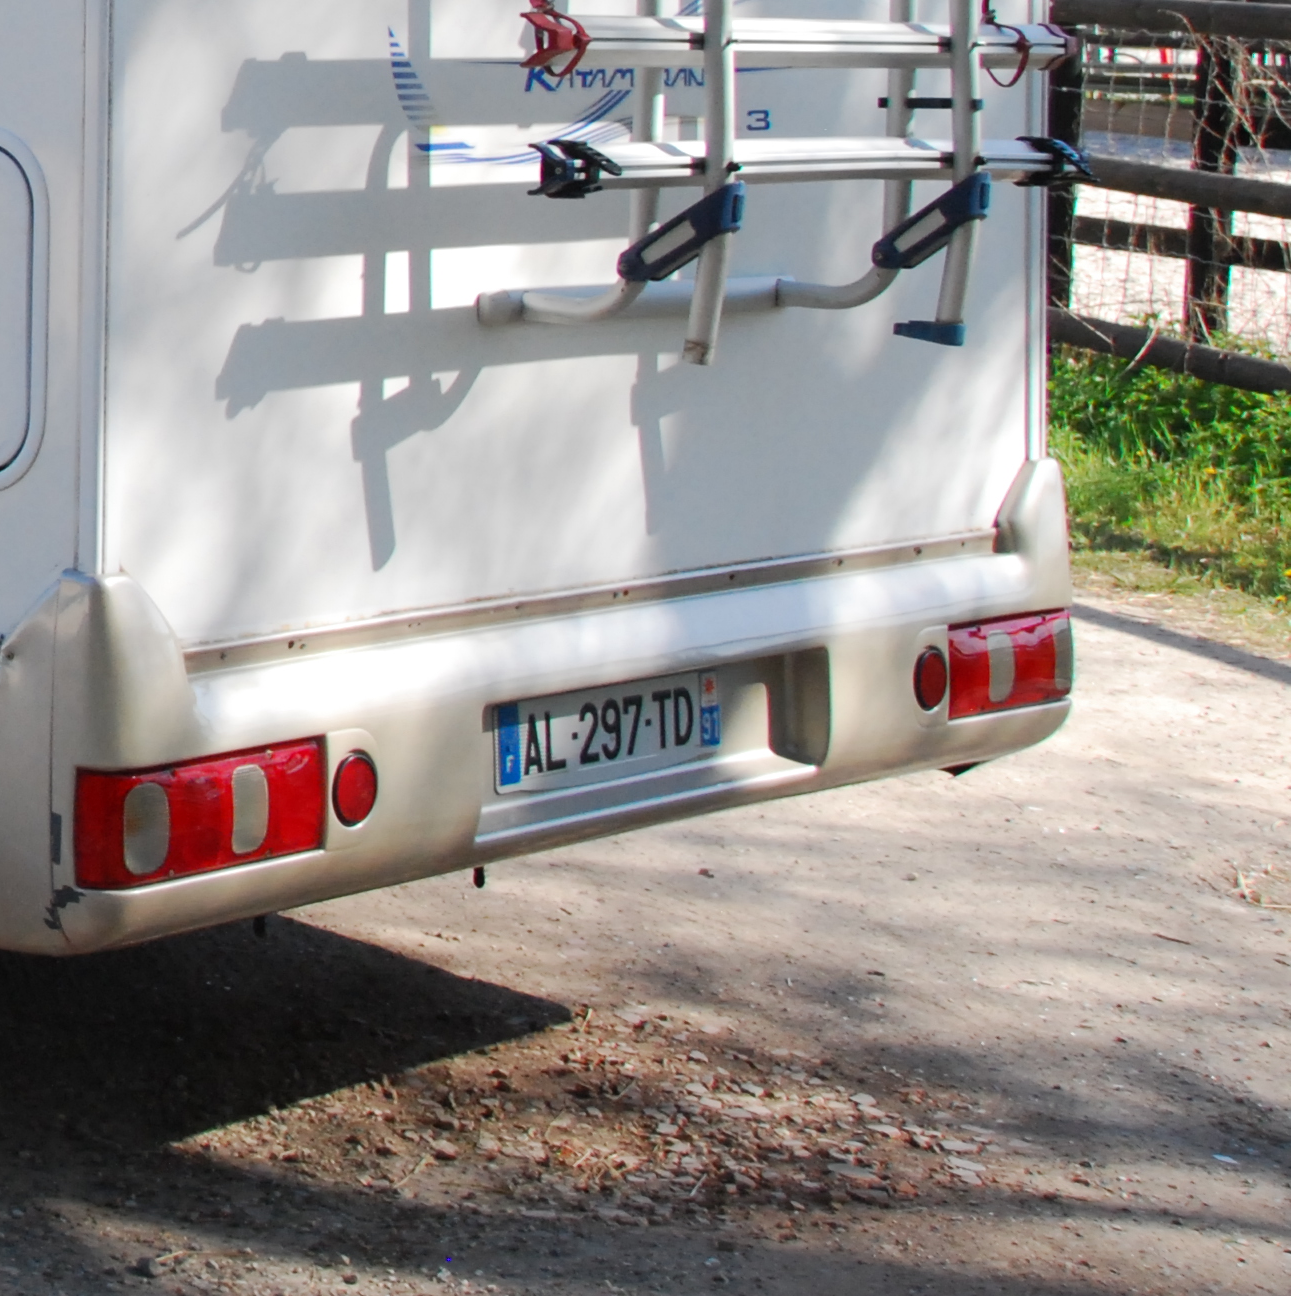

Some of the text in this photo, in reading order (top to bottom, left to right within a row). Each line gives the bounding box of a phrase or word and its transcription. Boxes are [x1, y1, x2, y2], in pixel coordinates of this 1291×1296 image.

[745, 109, 772, 131] 3
[702, 710, 721, 740] 91
[505, 754, 516, 774] F
